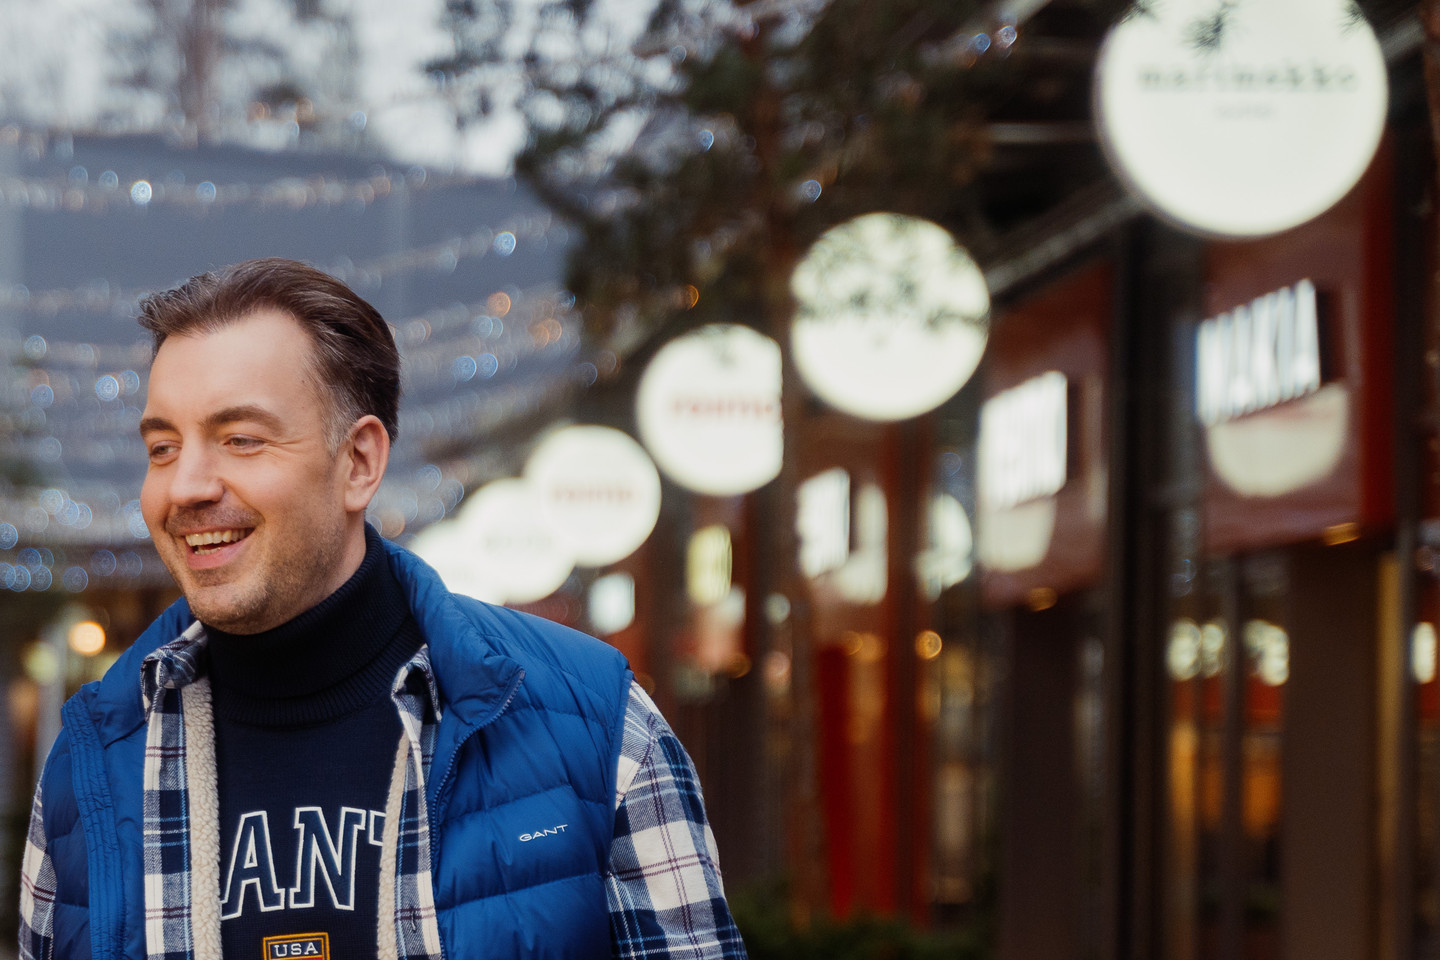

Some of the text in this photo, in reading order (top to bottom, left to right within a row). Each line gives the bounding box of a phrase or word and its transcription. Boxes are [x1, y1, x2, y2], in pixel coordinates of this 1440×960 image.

[519, 824, 569, 842] GANT
[220, 806, 387, 921] AN
[274, 942, 319, 957] USA
